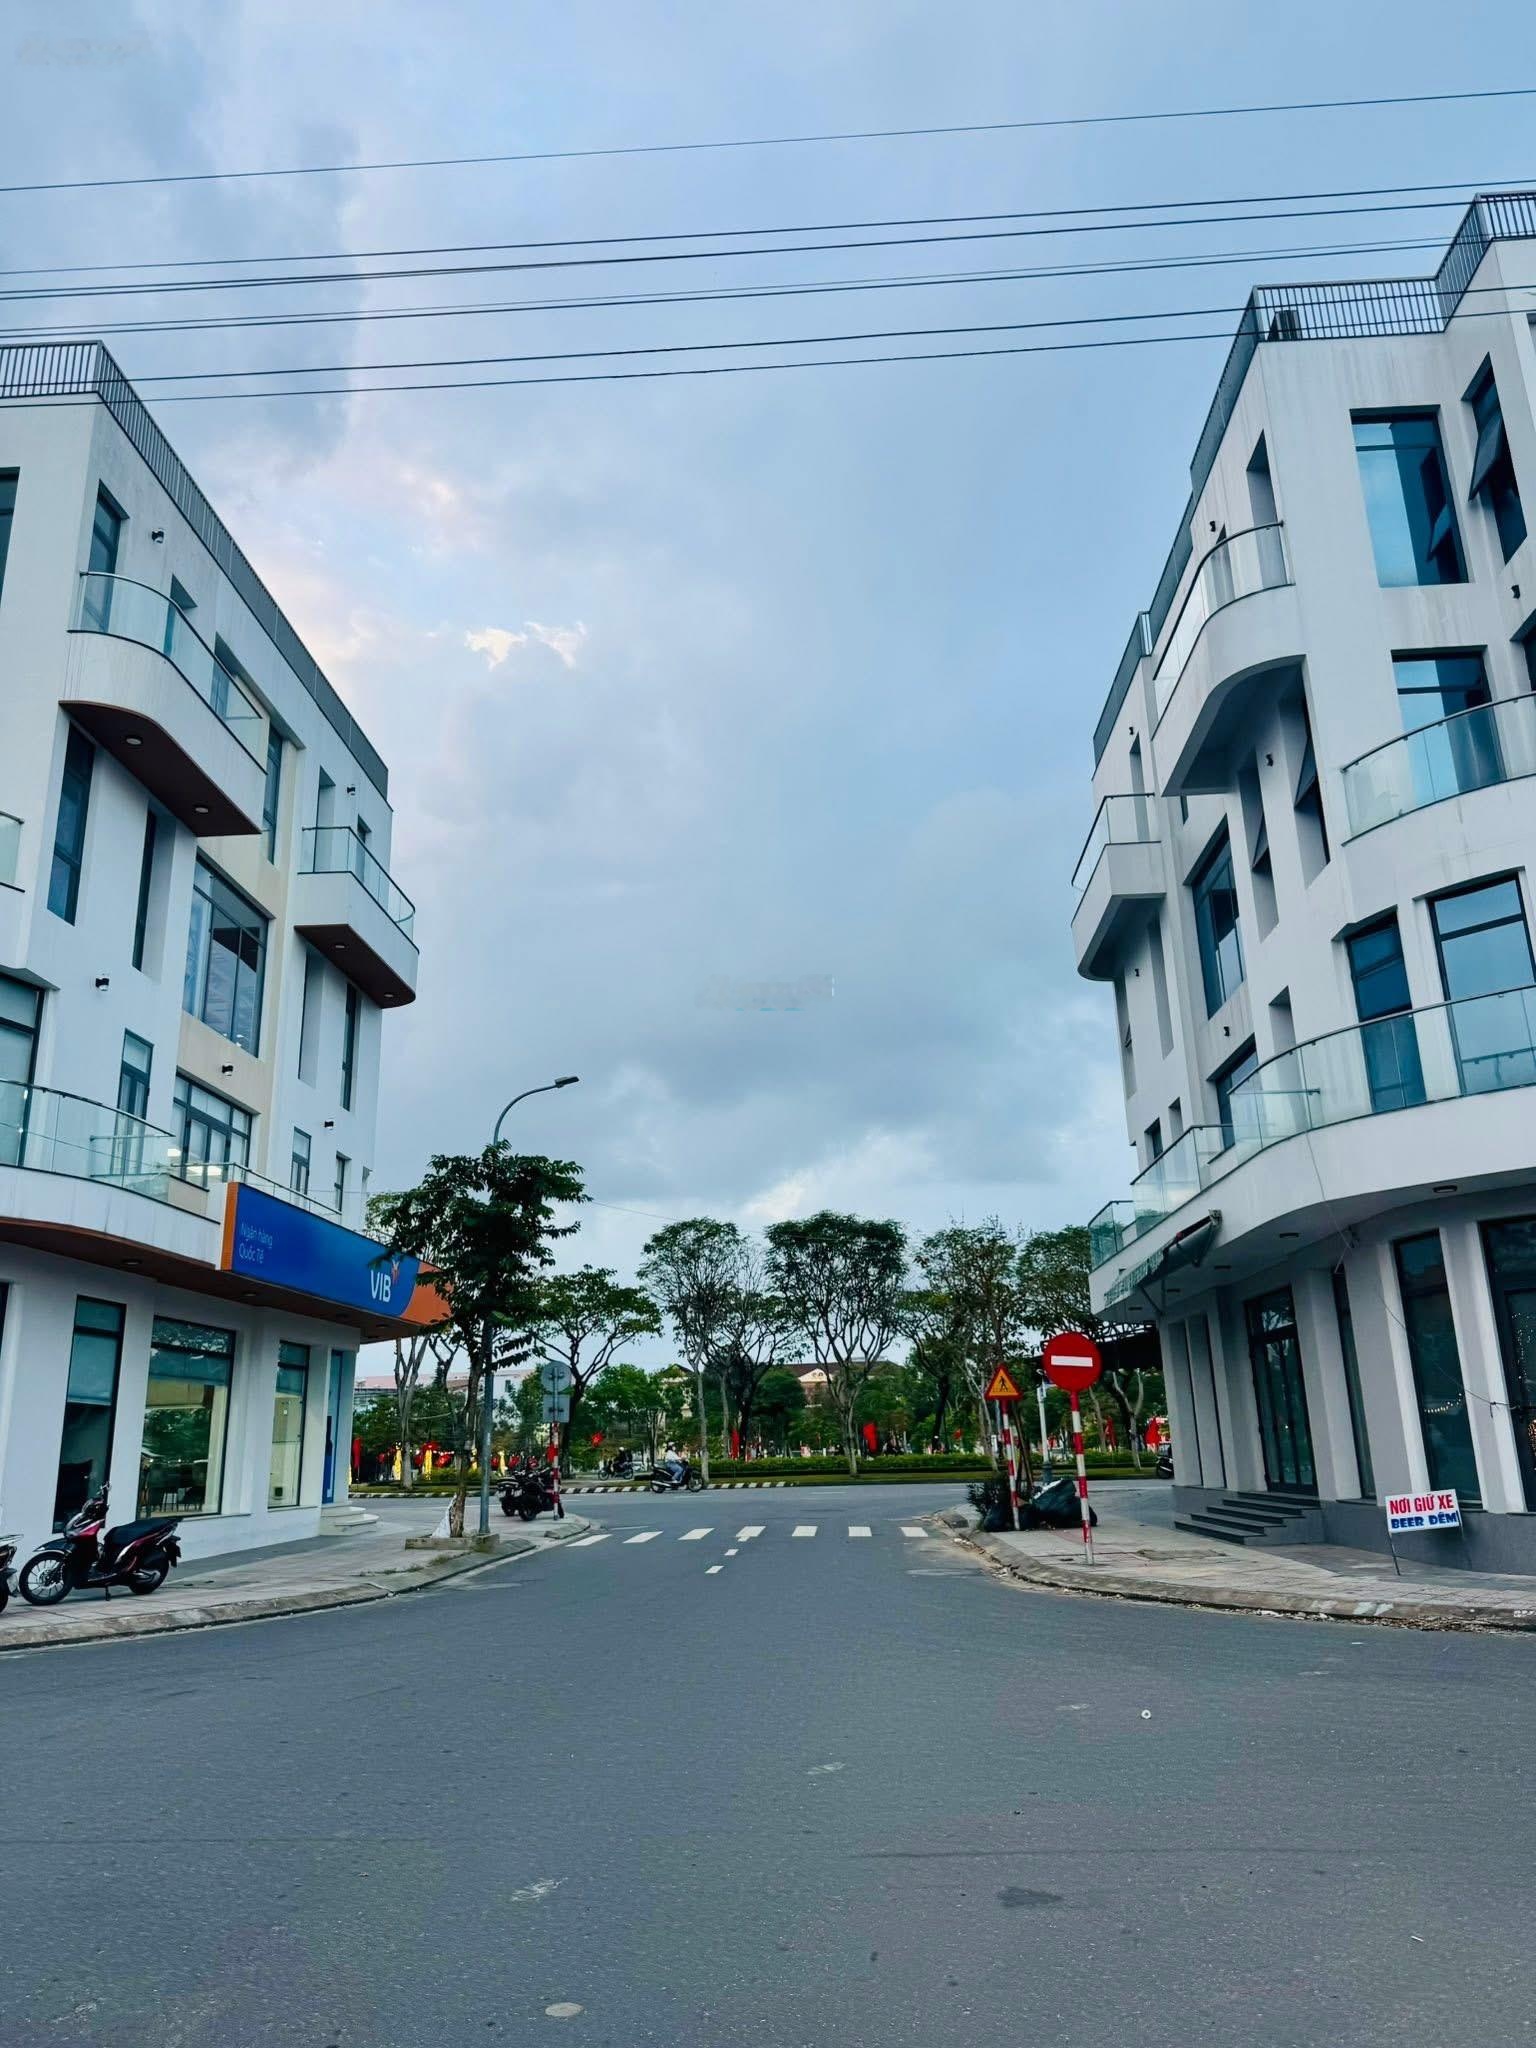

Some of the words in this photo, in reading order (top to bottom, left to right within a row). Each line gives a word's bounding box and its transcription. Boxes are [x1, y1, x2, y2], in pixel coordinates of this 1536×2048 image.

[370, 1269, 392, 1303] VIB
[1389, 1498, 1411, 1515] NƠI
[1414, 1493, 1435, 1513] GIỮ
[1437, 1494, 1454, 1509] XE
[1391, 1516, 1424, 1529] BEER
